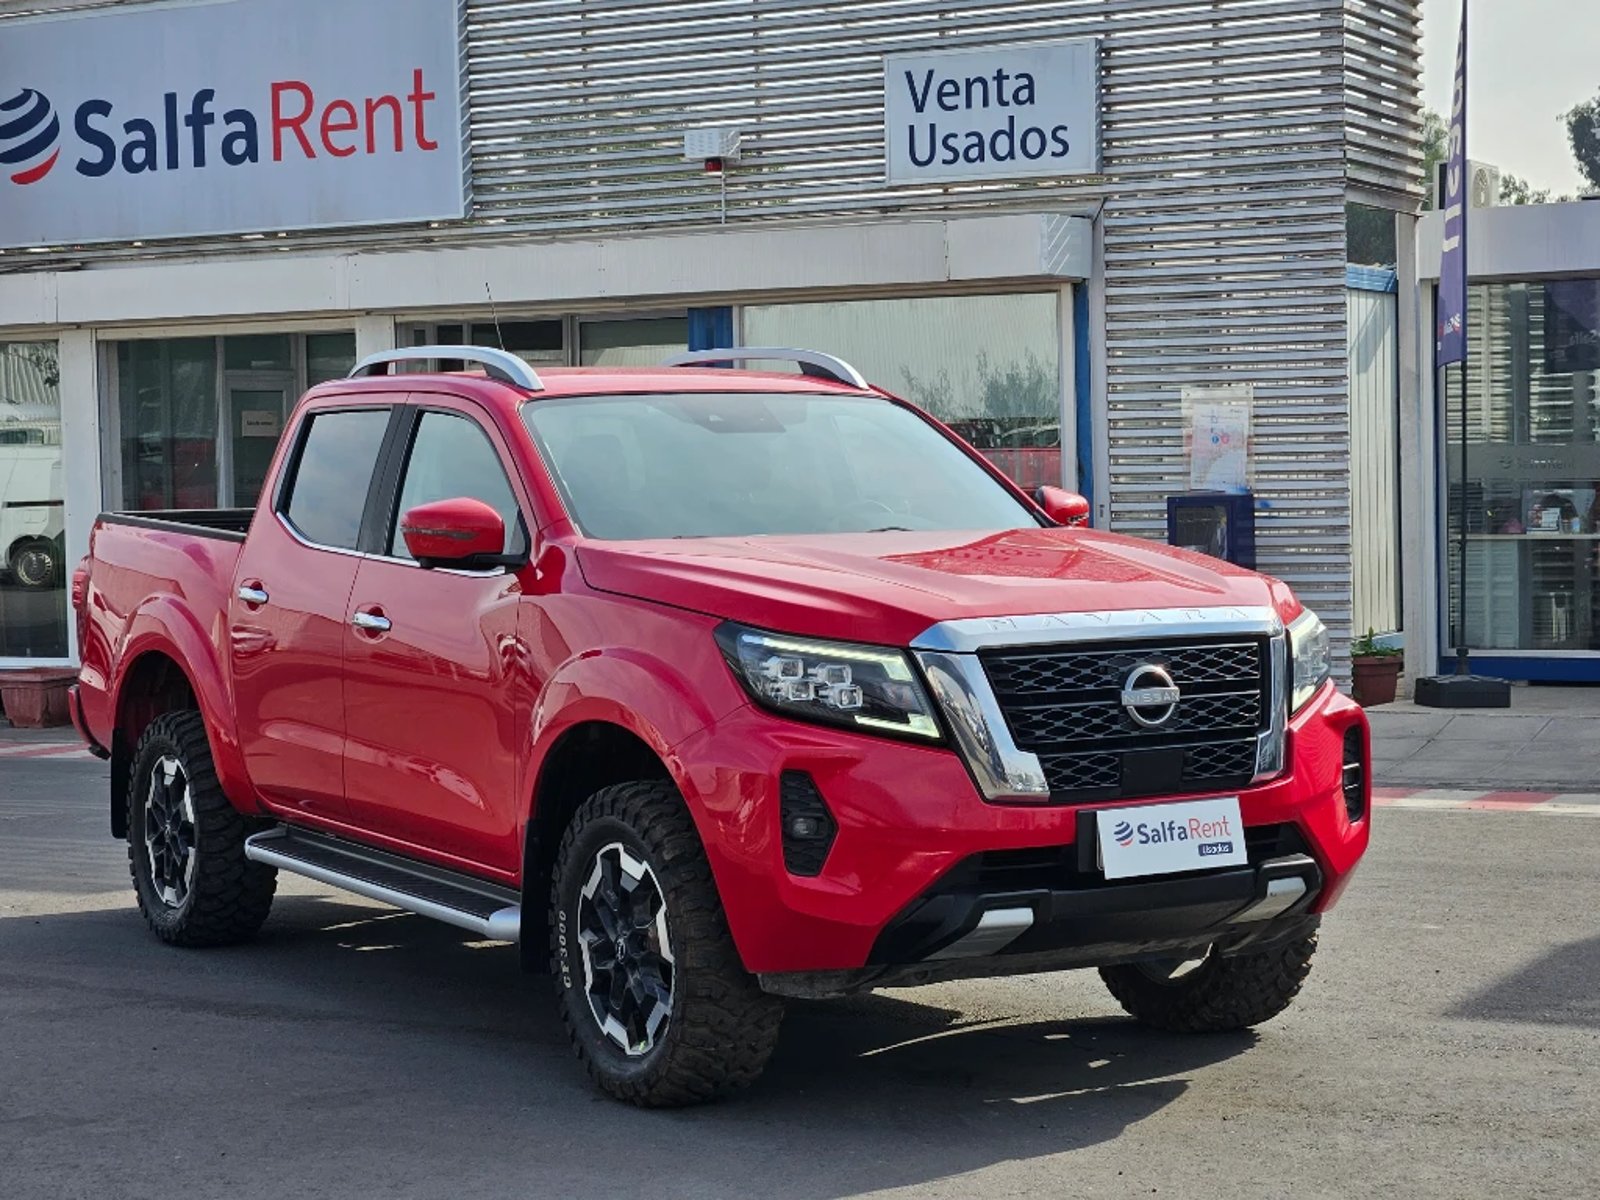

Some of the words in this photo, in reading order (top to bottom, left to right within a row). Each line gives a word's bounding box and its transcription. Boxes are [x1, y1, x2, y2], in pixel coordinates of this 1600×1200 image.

[904, 68, 1036, 113] Venta
[908, 115, 1070, 167] Usados
[1124, 691, 1180, 704] NISSAN
[1136, 815, 1232, 844] SalfaRent
